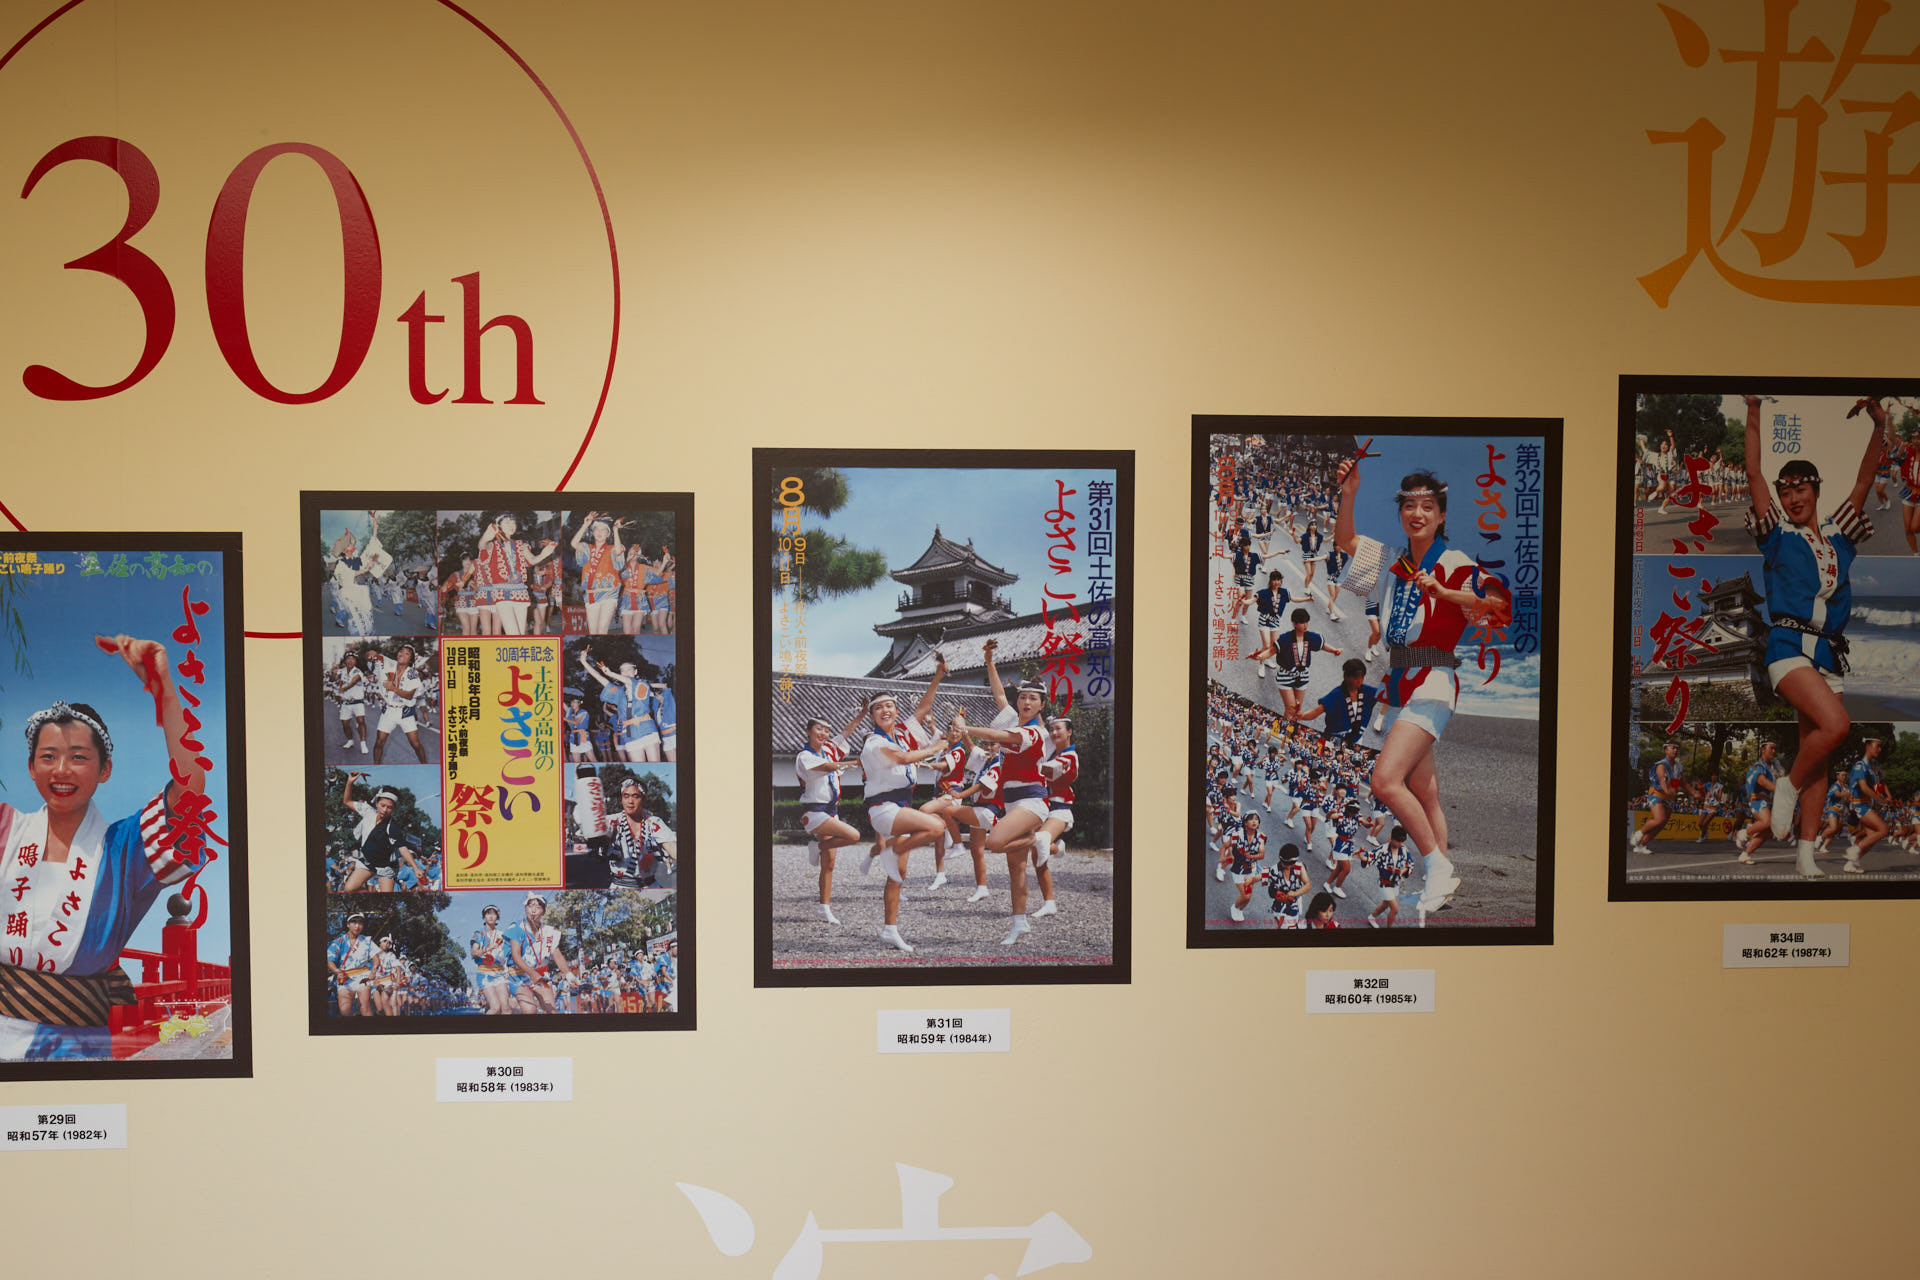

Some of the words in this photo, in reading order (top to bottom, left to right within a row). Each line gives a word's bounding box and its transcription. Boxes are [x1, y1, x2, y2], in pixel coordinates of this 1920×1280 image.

[1636, 0, 1920, 309] 遊
[20, 135, 545, 405] 30th
[1772, 414, 1788, 454] 高知の
[1788, 413, 1802, 454] 土佐の
[778, 476, 806, 536] 8月
[1468, 444, 1511, 686] よさこい祭り
[1513, 443, 1541, 654] 第32回土佐の高知の
[1037, 479, 1085, 720] よさこい祭り
[1087, 480, 1114, 698] 第31回土佐の高知の
[1649, 453, 1720, 735] よさこい祭り
[467, 647, 481, 721] 昭和58年8月
[496, 646, 554, 663] 30周年記念
[447, 706, 458, 780] よさこい鳴子踊り
[497, 665, 541, 821] よさこい
[533, 665, 554, 772] 土佐の高知の
[158, 584, 229, 930] よさこい祭り
[448, 782, 496, 870] 祭り
[6, 842, 39, 968] 鳴子踊り
[36, 857, 87, 972] よさこい
[1770, 933, 1805, 943] 第34回
[1353, 978, 1389, 989] 第32回
[1742, 948, 1788, 959] 昭和62年
[1791, 948, 1831, 958] (1987年)
[926, 1018, 963, 1029] 第31回
[1325, 993, 1372, 1005] 昭和60年
[1376, 993, 1417, 1005] (1985年)
[486, 1066, 524, 1077] 第30回
[897, 1033, 946, 1044] 昭和59年
[950, 1033, 992, 1044] (1984年)
[37, 1114, 76, 1126] 第29回
[456, 1082, 507, 1093] 昭和58年
[510, 1081, 554, 1093] (1983年)
[7, 1130, 59, 1142] 昭和57年
[62, 1129, 107, 1141] (1982年)
